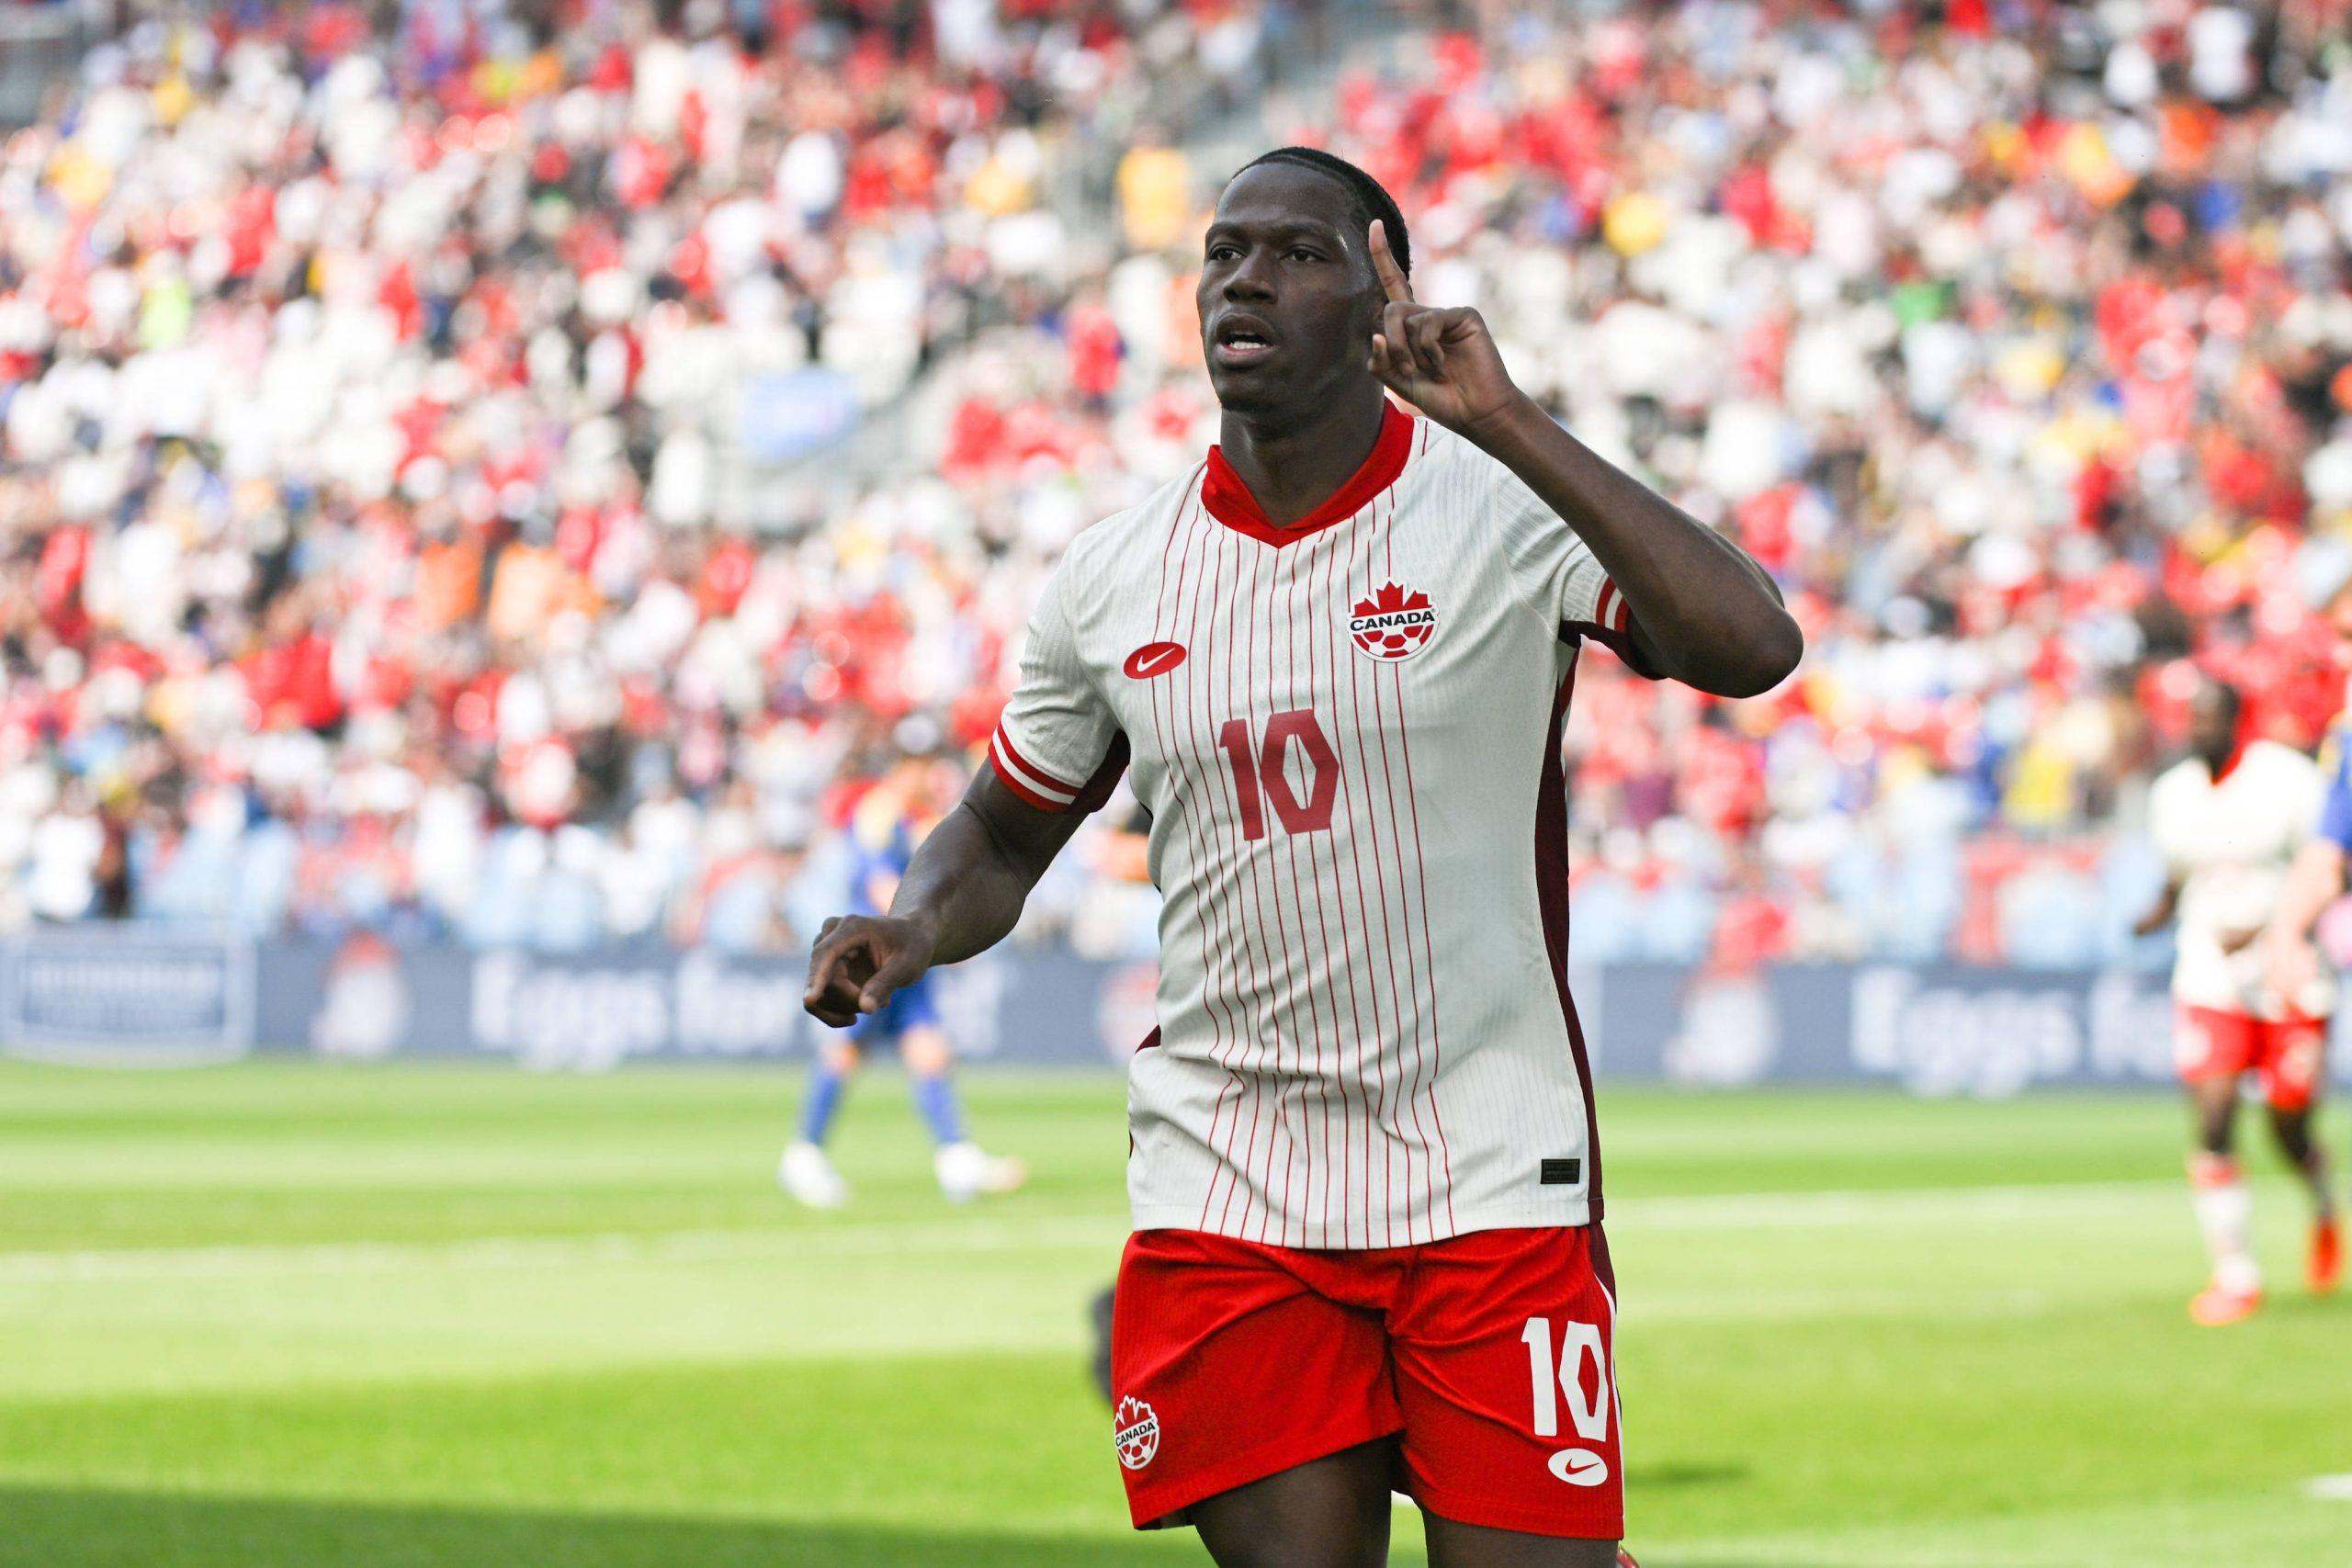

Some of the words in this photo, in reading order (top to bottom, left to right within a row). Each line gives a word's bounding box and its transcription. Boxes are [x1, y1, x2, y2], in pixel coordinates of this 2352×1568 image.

[1350, 610, 1435, 631] CANADA
[1219, 708, 1340, 841] 10
[1521, 1316, 1609, 1442] 10
[1115, 1421, 1156, 1447] CANADA
